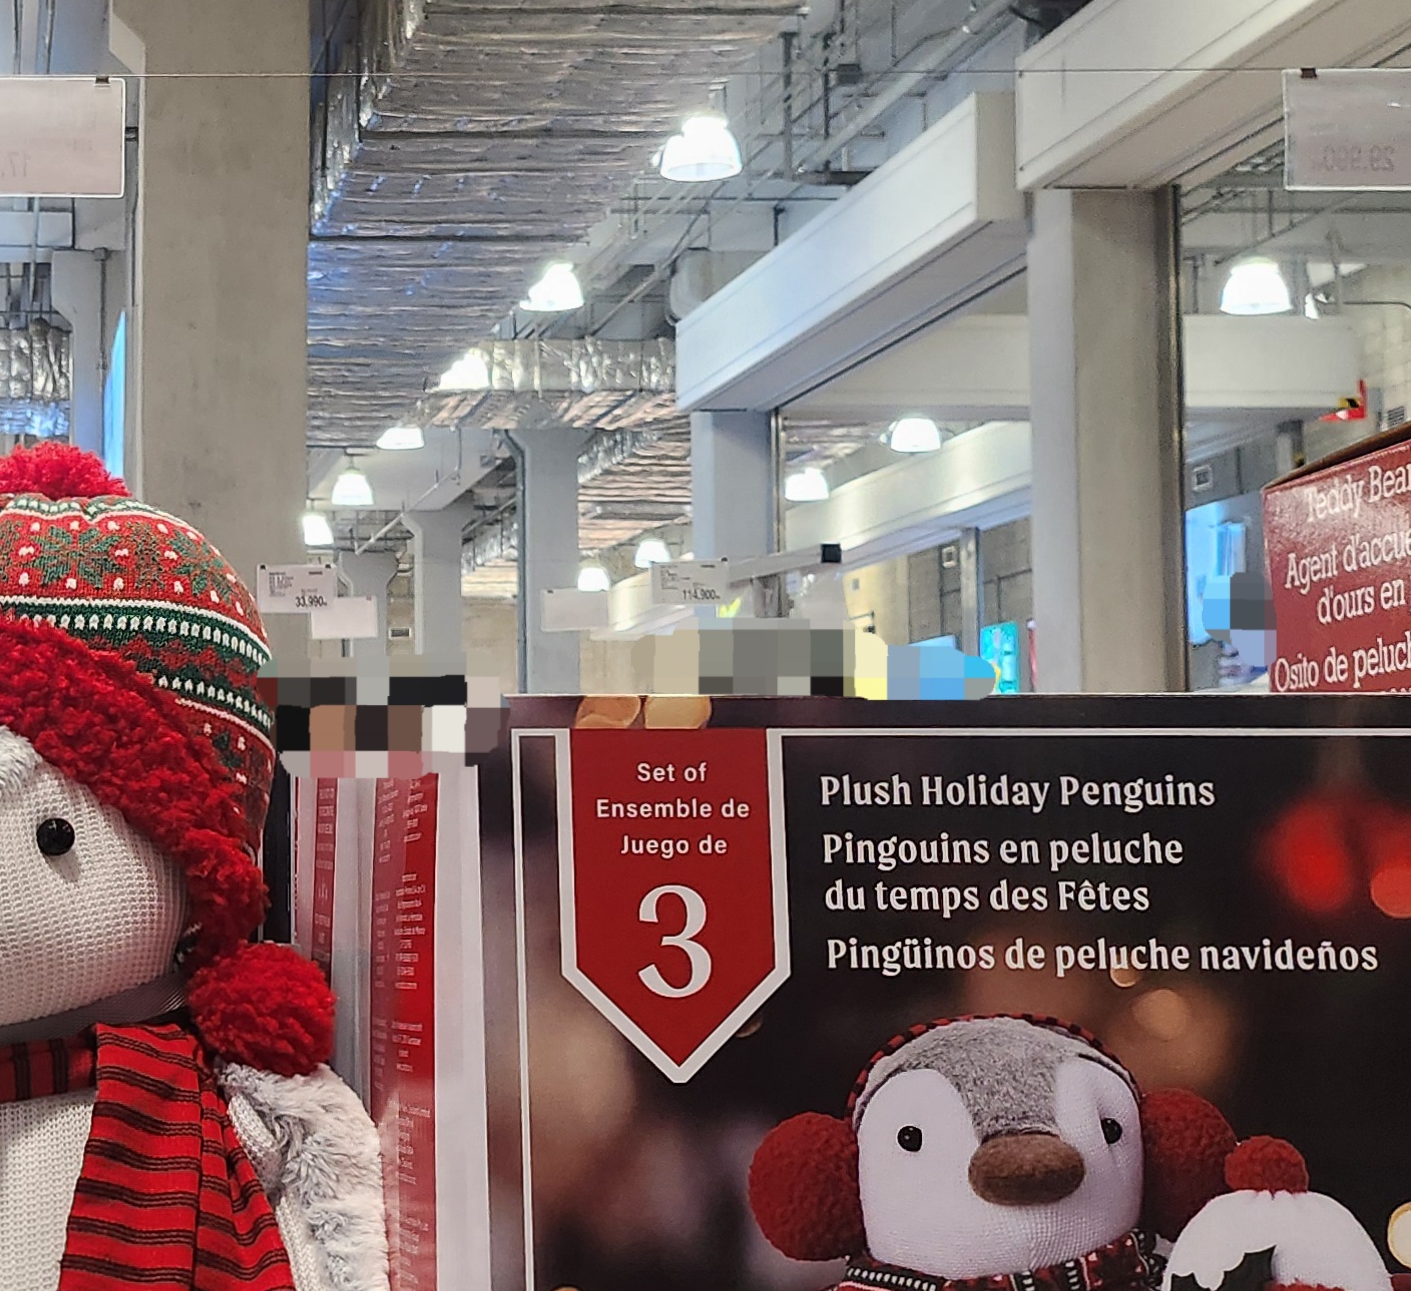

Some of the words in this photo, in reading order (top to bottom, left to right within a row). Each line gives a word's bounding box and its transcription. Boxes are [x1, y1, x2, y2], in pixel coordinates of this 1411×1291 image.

[1304, 475, 1364, 522] Teddy
[1285, 543, 1338, 595] Agent
[295, 596, 327, 608] 33,990
[683, 589, 720, 600] 114,900
[1317, 584, 1375, 625] d'ours
[1380, 578, 1406, 609] en
[1275, 653, 1319, 692] Osito
[1324, 646, 1348, 683] de
[638, 763, 675, 781] Set
[685, 763, 706, 781] of
[597, 799, 711, 817] Ensemble
[722, 799, 749, 817] de
[821, 774, 911, 804] Plush
[922, 775, 1049, 813] Holiday
[1060, 775, 1214, 812] Penguins
[621, 836, 688, 858] Juego
[699, 835, 726, 853] de
[824, 833, 989, 870] Pingouins
[1000, 840, 1039, 863] en
[1050, 833, 1182, 871] peluche
[826, 879, 865, 910] du
[875, 882, 979, 918] temps
[990, 879, 1047, 910] des
[1058, 880, 1149, 910] Fêtes
[639, 885, 711, 997] 3
[828, 938, 994, 976] Pingüinos
[1006, 938, 1044, 969] de
[1056, 938, 1189, 977] peluche
[1200, 939, 1377, 970] navideños
